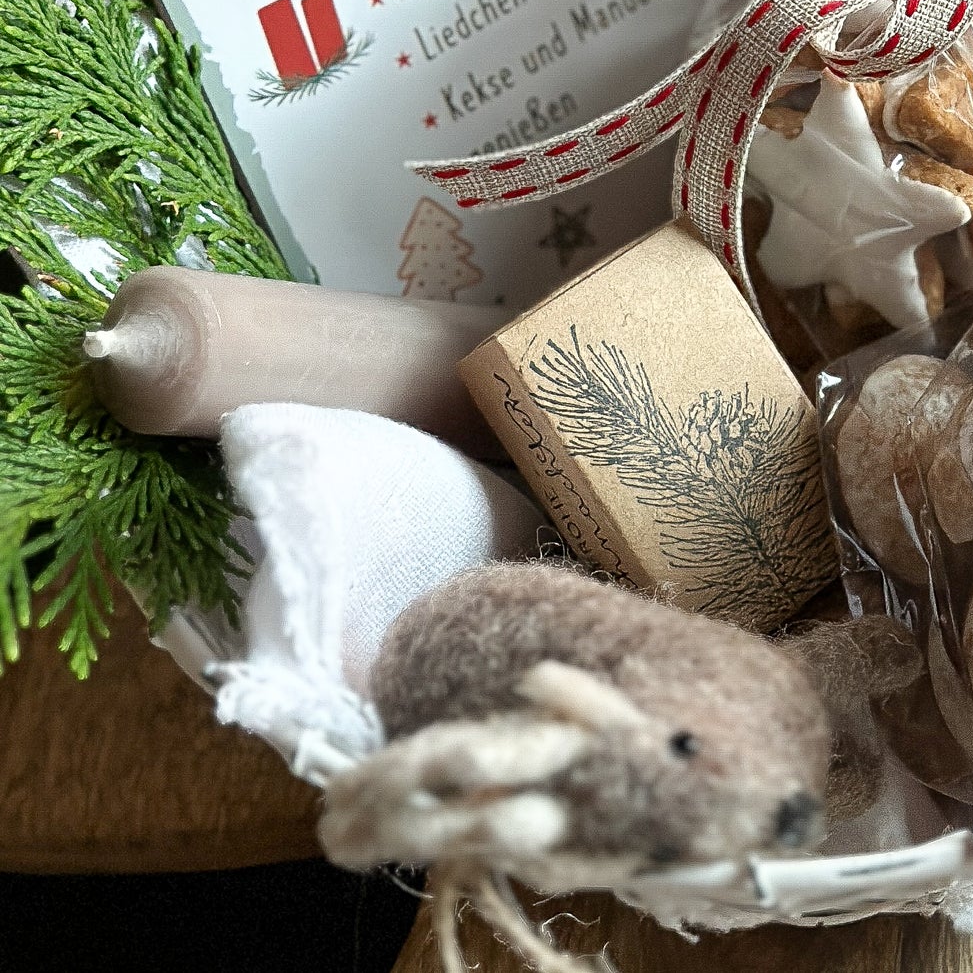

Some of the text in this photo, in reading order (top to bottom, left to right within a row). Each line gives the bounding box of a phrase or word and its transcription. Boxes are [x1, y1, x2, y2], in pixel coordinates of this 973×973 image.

[440, 65, 515, 121] Kekse
[521, 21, 568, 75] und
[543, 486, 594, 557] ROHE
